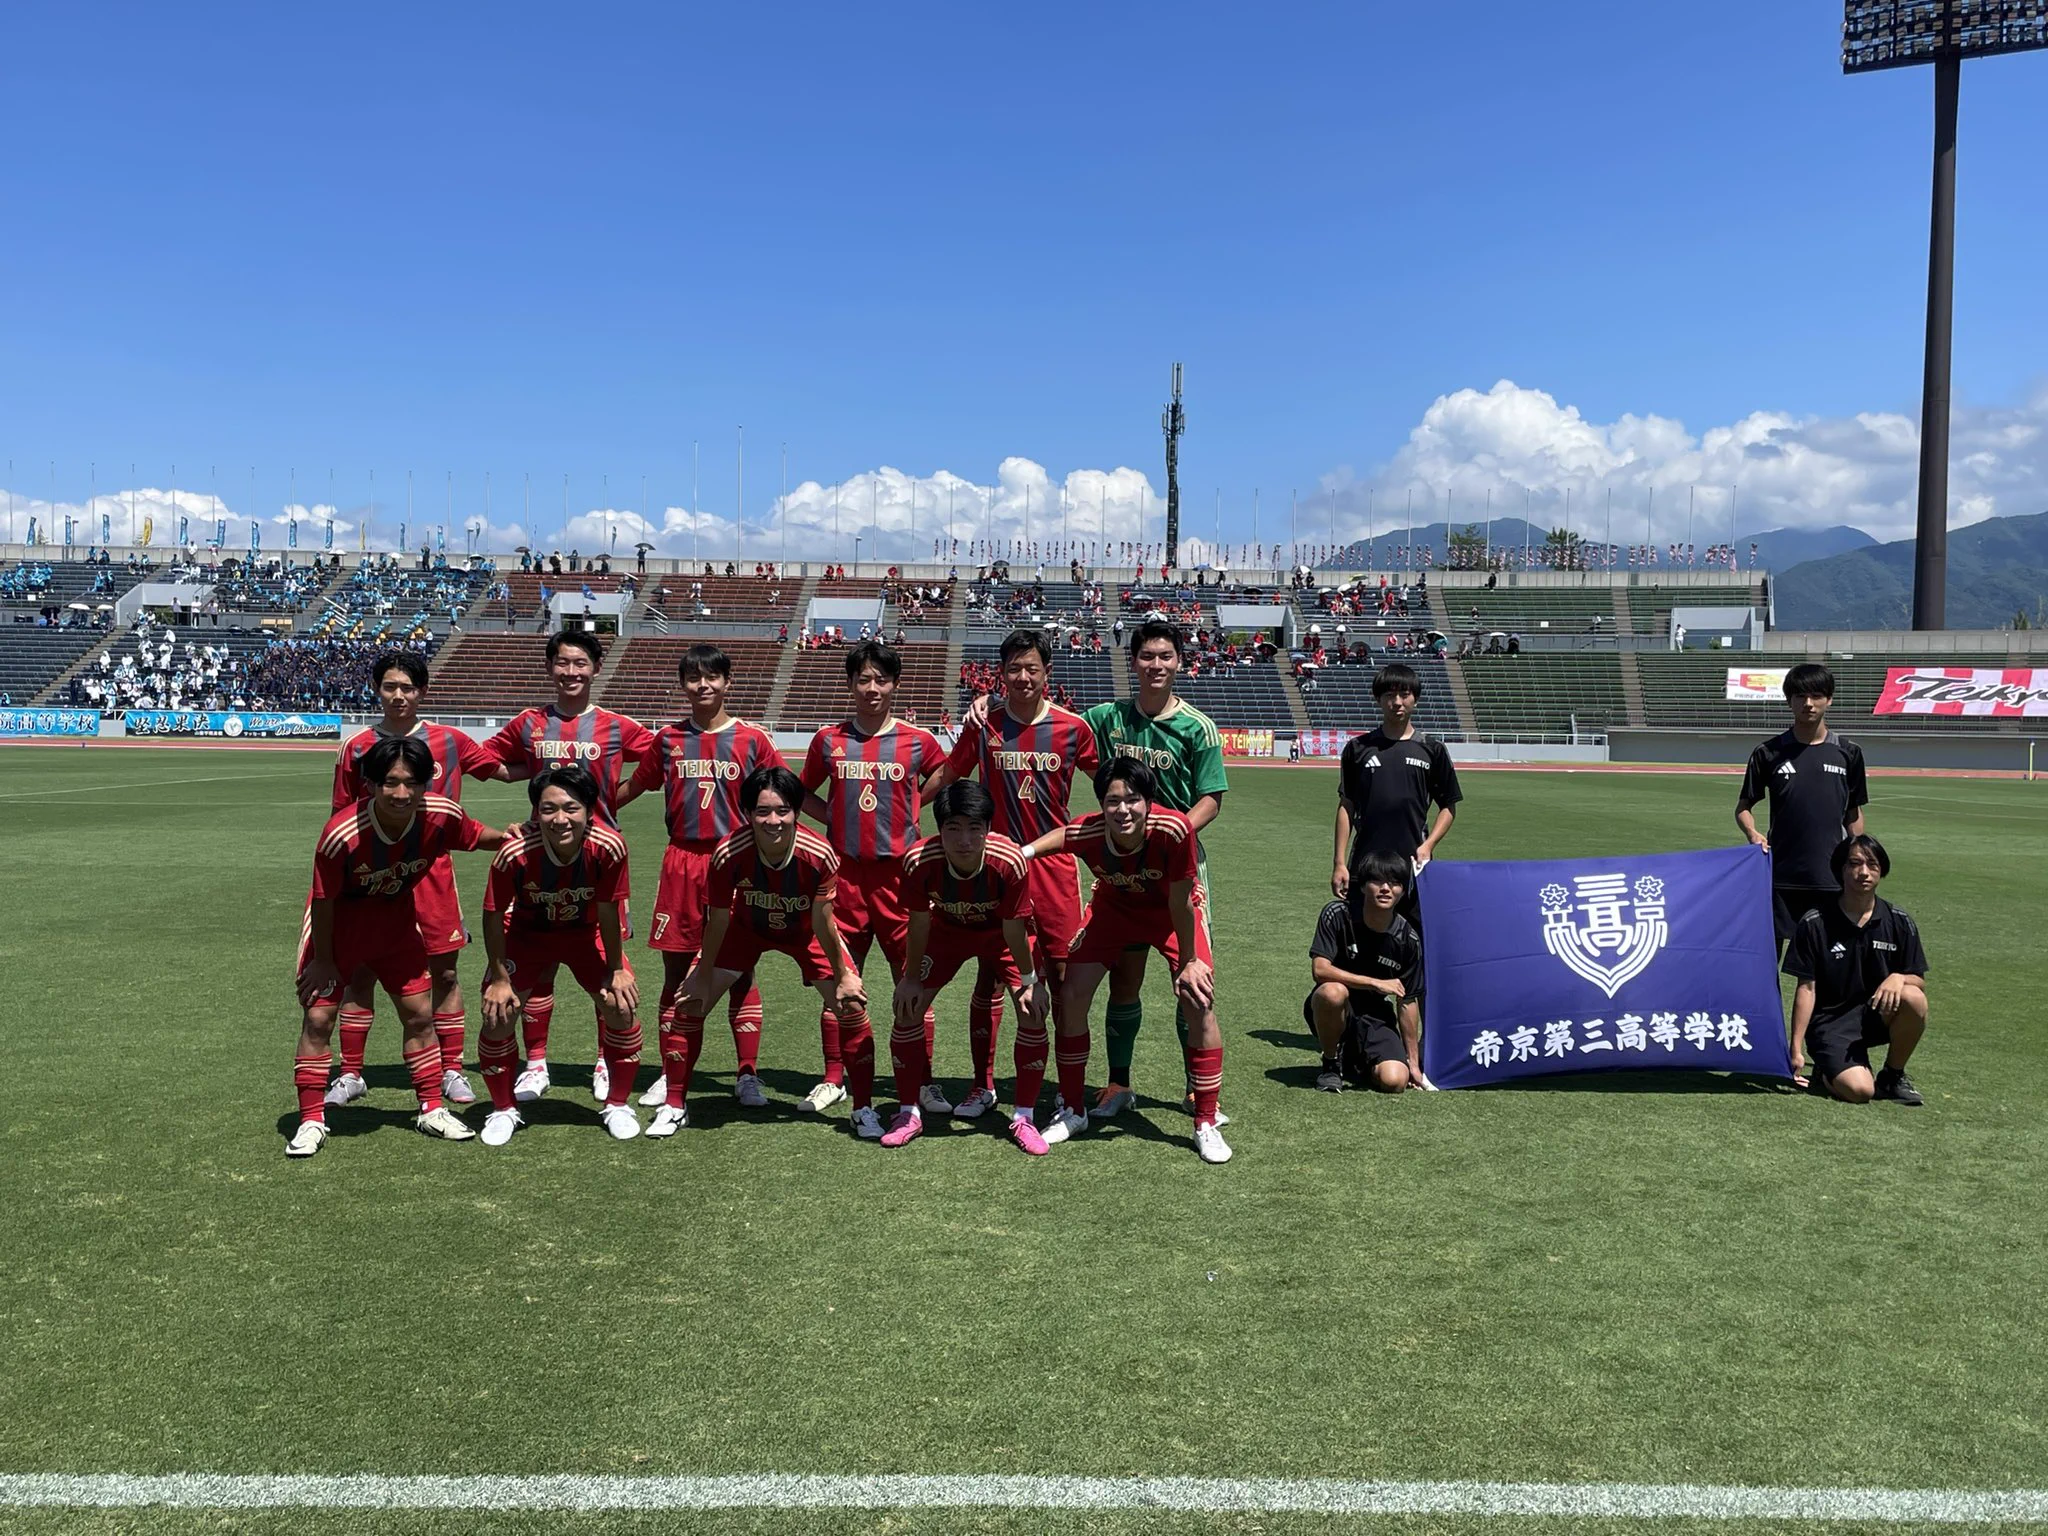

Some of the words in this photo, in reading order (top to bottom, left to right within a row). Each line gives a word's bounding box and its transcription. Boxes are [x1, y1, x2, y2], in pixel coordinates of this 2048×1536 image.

[292, 723, 338, 737] Champion
[534, 741, 600, 760] TEIKYO
[1114, 743, 1172, 770] TEIKYO
[675, 759, 740, 780] TEIKYO
[836, 760, 905, 781] TEIKYO
[993, 751, 1061, 772] TEIKYO
[1405, 757, 1430, 770] TEIKYO
[698, 781, 716, 809] 7
[859, 783, 877, 812] 6
[1018, 775, 1036, 803] 4
[546, 903, 580, 921] 12
[743, 890, 811, 913] TEIKYO
[654, 912, 670, 940] 7
[768, 912, 787, 930] 5
[1378, 956, 1401, 970] TEIKYO
[1470, 1012, 1753, 1069] 帝京第三高等学校
